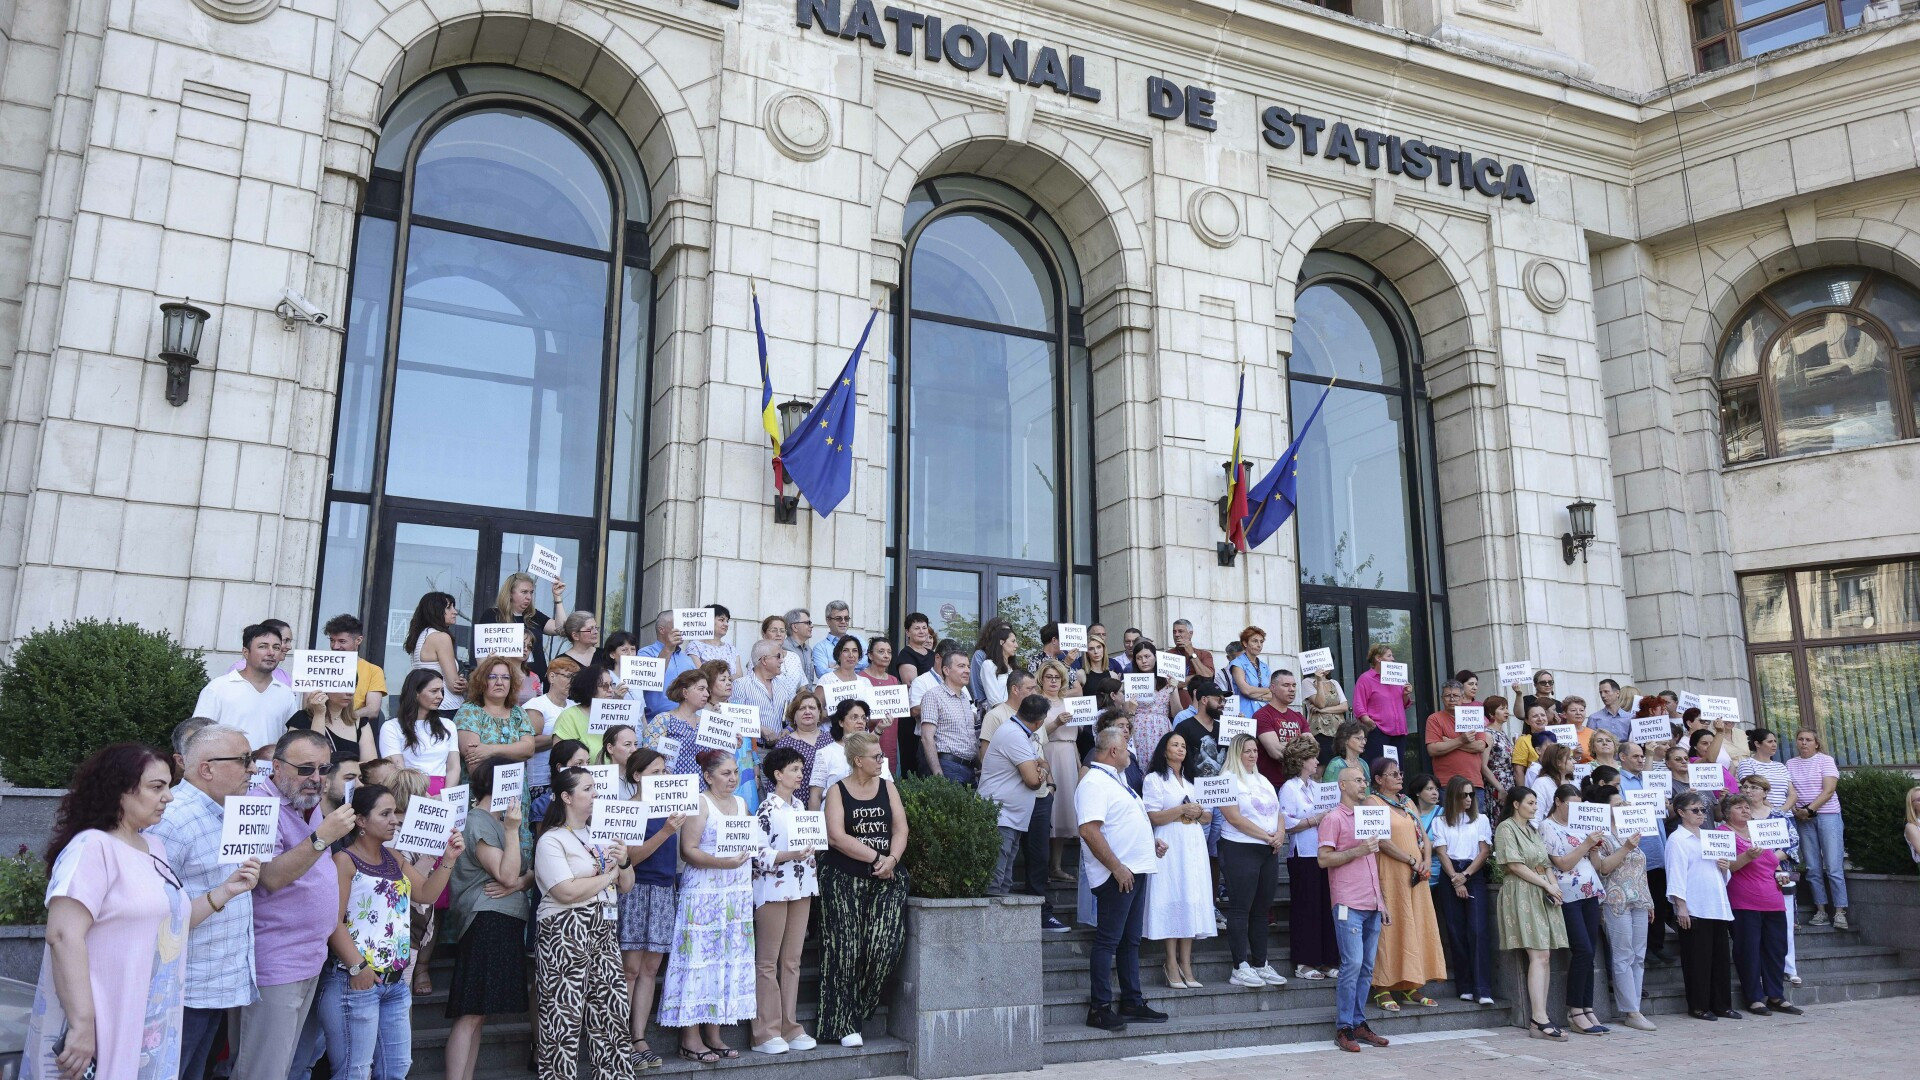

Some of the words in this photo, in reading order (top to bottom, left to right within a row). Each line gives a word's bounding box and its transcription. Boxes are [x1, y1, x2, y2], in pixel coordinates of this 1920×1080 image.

[797, 0, 1101, 103] NATIONAL
[1147, 75, 1217, 132] DE
[1262, 106, 1535, 204] STATISTICA
[540, 550, 558, 562] RESPECT
[538, 558, 557, 571] PENTRU
[307, 655, 346, 663] RESPECT
[294, 680, 354, 688] STATISTICIAN
[623, 679, 663, 687] STATISTICIAN
[832, 685, 856, 693] RESPECT
[709, 716, 734, 728] RESPECT
[708, 727, 731, 737] PENTRU
[1635, 732, 1670, 741] STATISTICIAN
[698, 734, 736, 750] STATISTICIAN
[502, 768, 520, 778] RESPECT
[501, 782, 520, 791] PENTRU
[654, 779, 688, 788] RESPECT
[1204, 779, 1229, 787] RESPECT
[448, 791, 465, 801] RESPECT
[655, 792, 688, 800] PENTRU
[239, 805, 272, 816] RESPECT
[418, 804, 448, 818] RESPECT
[605, 805, 639, 815] RESPECT
[649, 803, 698, 813] TATISTICIAN
[414, 820, 444, 833] PENTRU
[604, 819, 637, 827] PENTRU
[239, 824, 269, 835] PENTRU
[1619, 826, 1657, 834] STATISTICIAN
[592, 831, 643, 840] STATISTICIAN
[400, 834, 447, 850] STATISTICIAN
[1754, 838, 1789, 846] STATISTICIAN
[222, 843, 273, 855] STATISTICIAN
